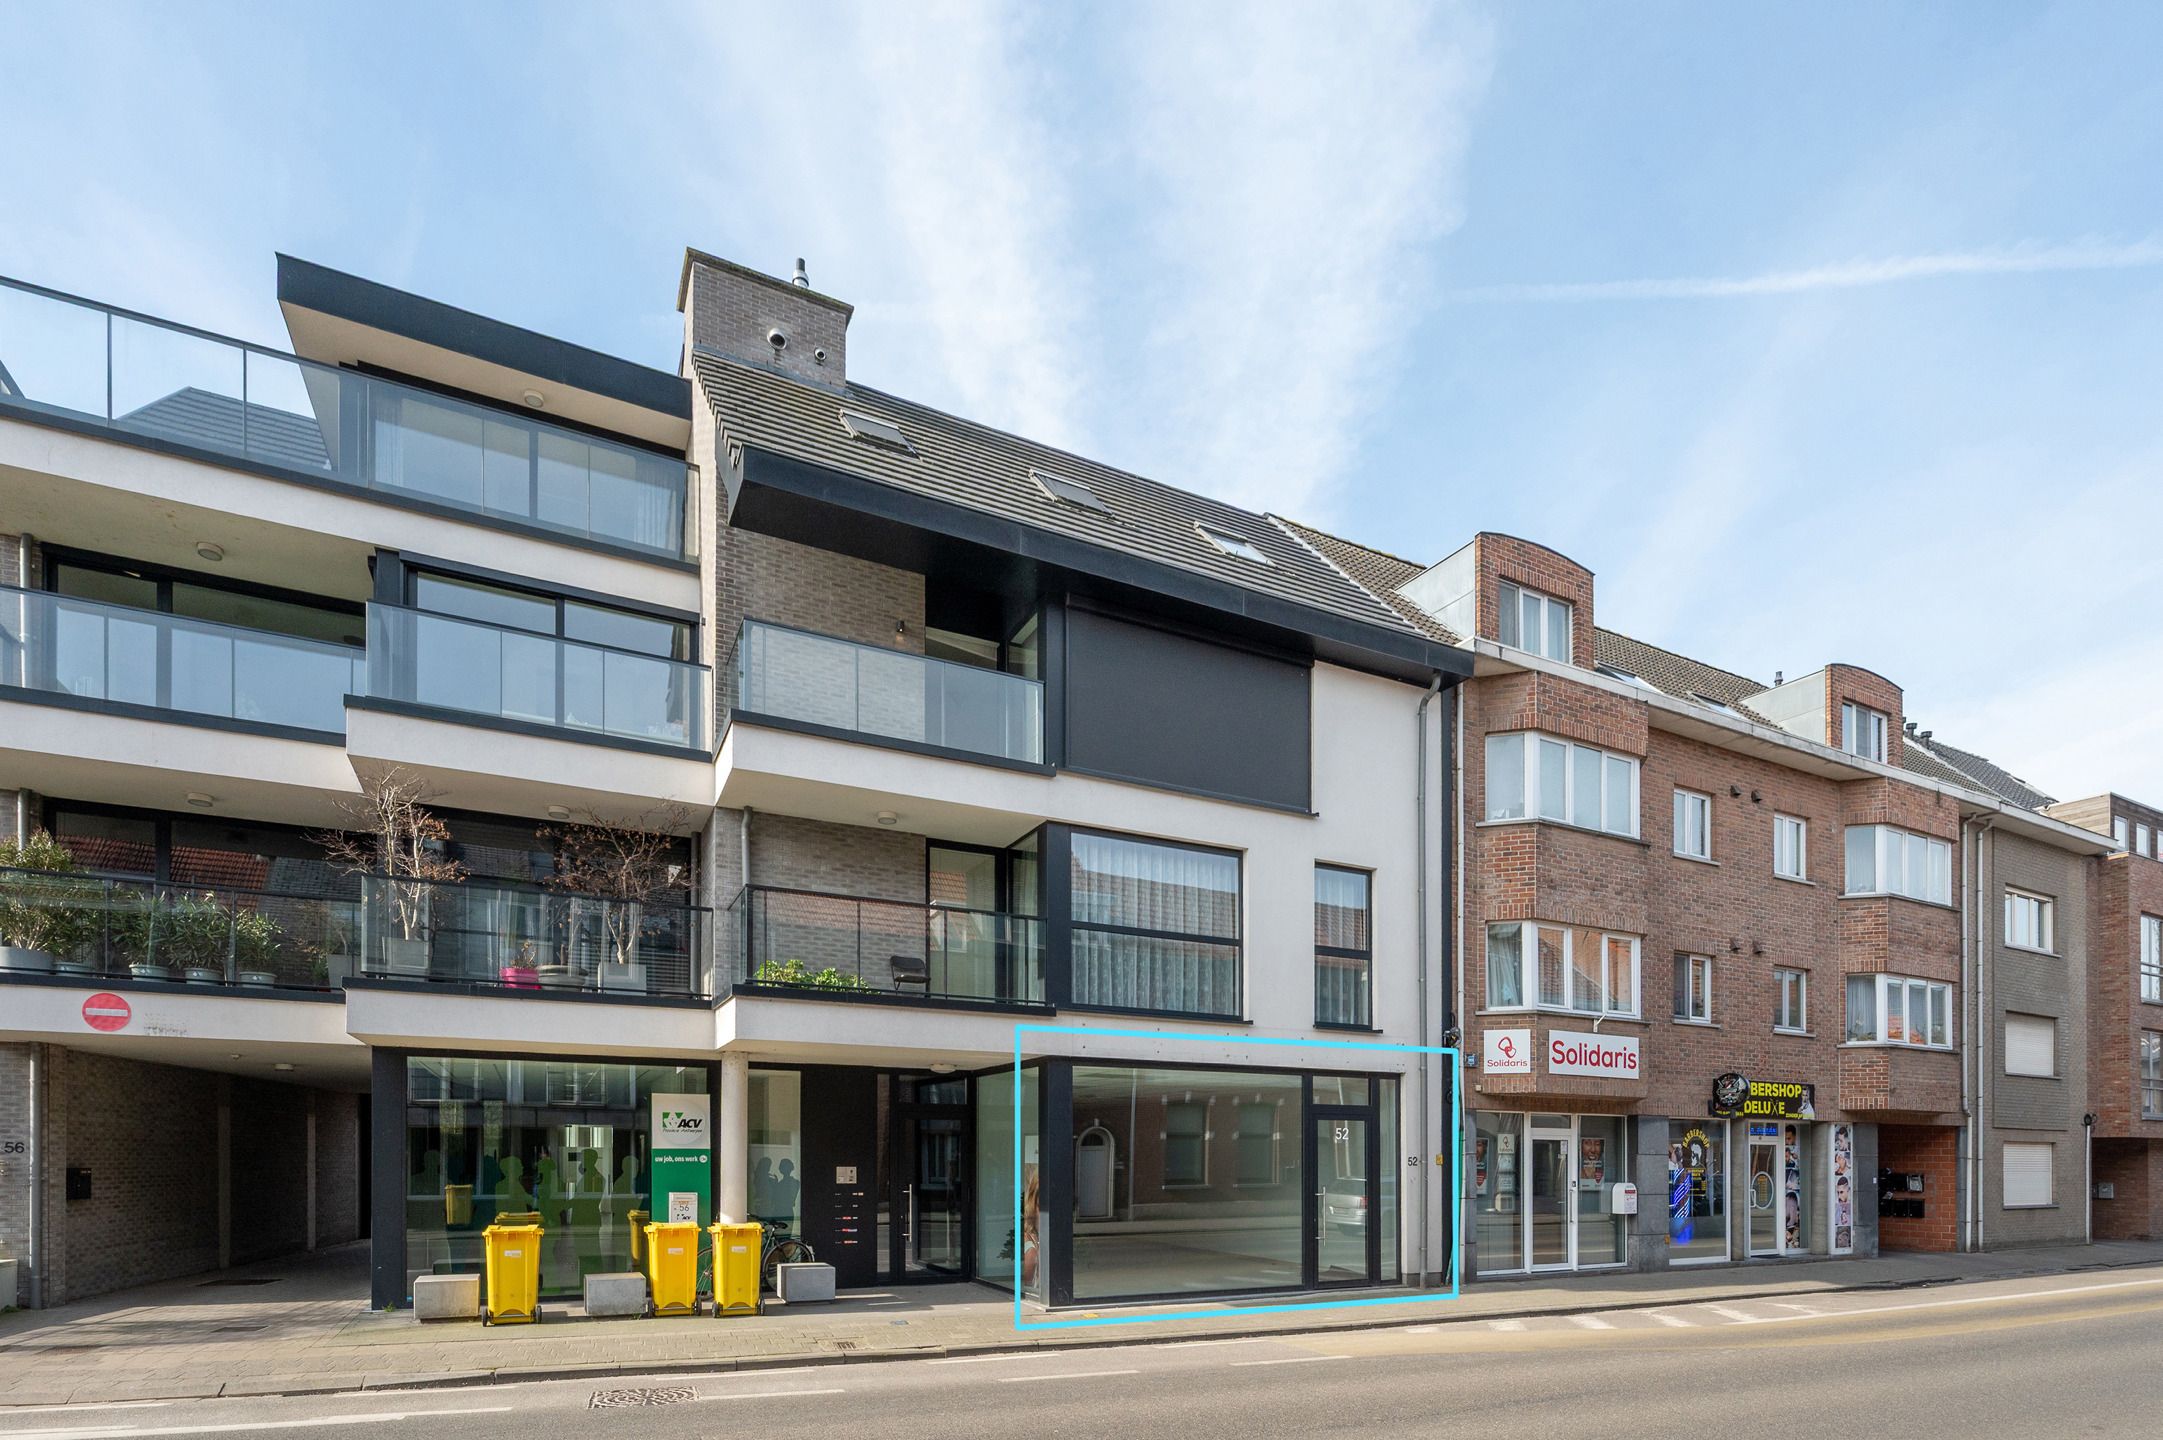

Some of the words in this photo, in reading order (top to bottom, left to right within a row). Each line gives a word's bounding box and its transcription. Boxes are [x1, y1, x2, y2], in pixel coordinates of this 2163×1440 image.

[1551, 1040, 1637, 1070] Solidaris
[1487, 1059, 1528, 1067] Solidaris
[677, 1118, 703, 1128] ACV
[1335, 1128, 1349, 1140] 52
[4, 1142, 25, 1153] 56
[663, 1155, 674, 1164] job,
[1407, 1157, 1418, 1166] 52
